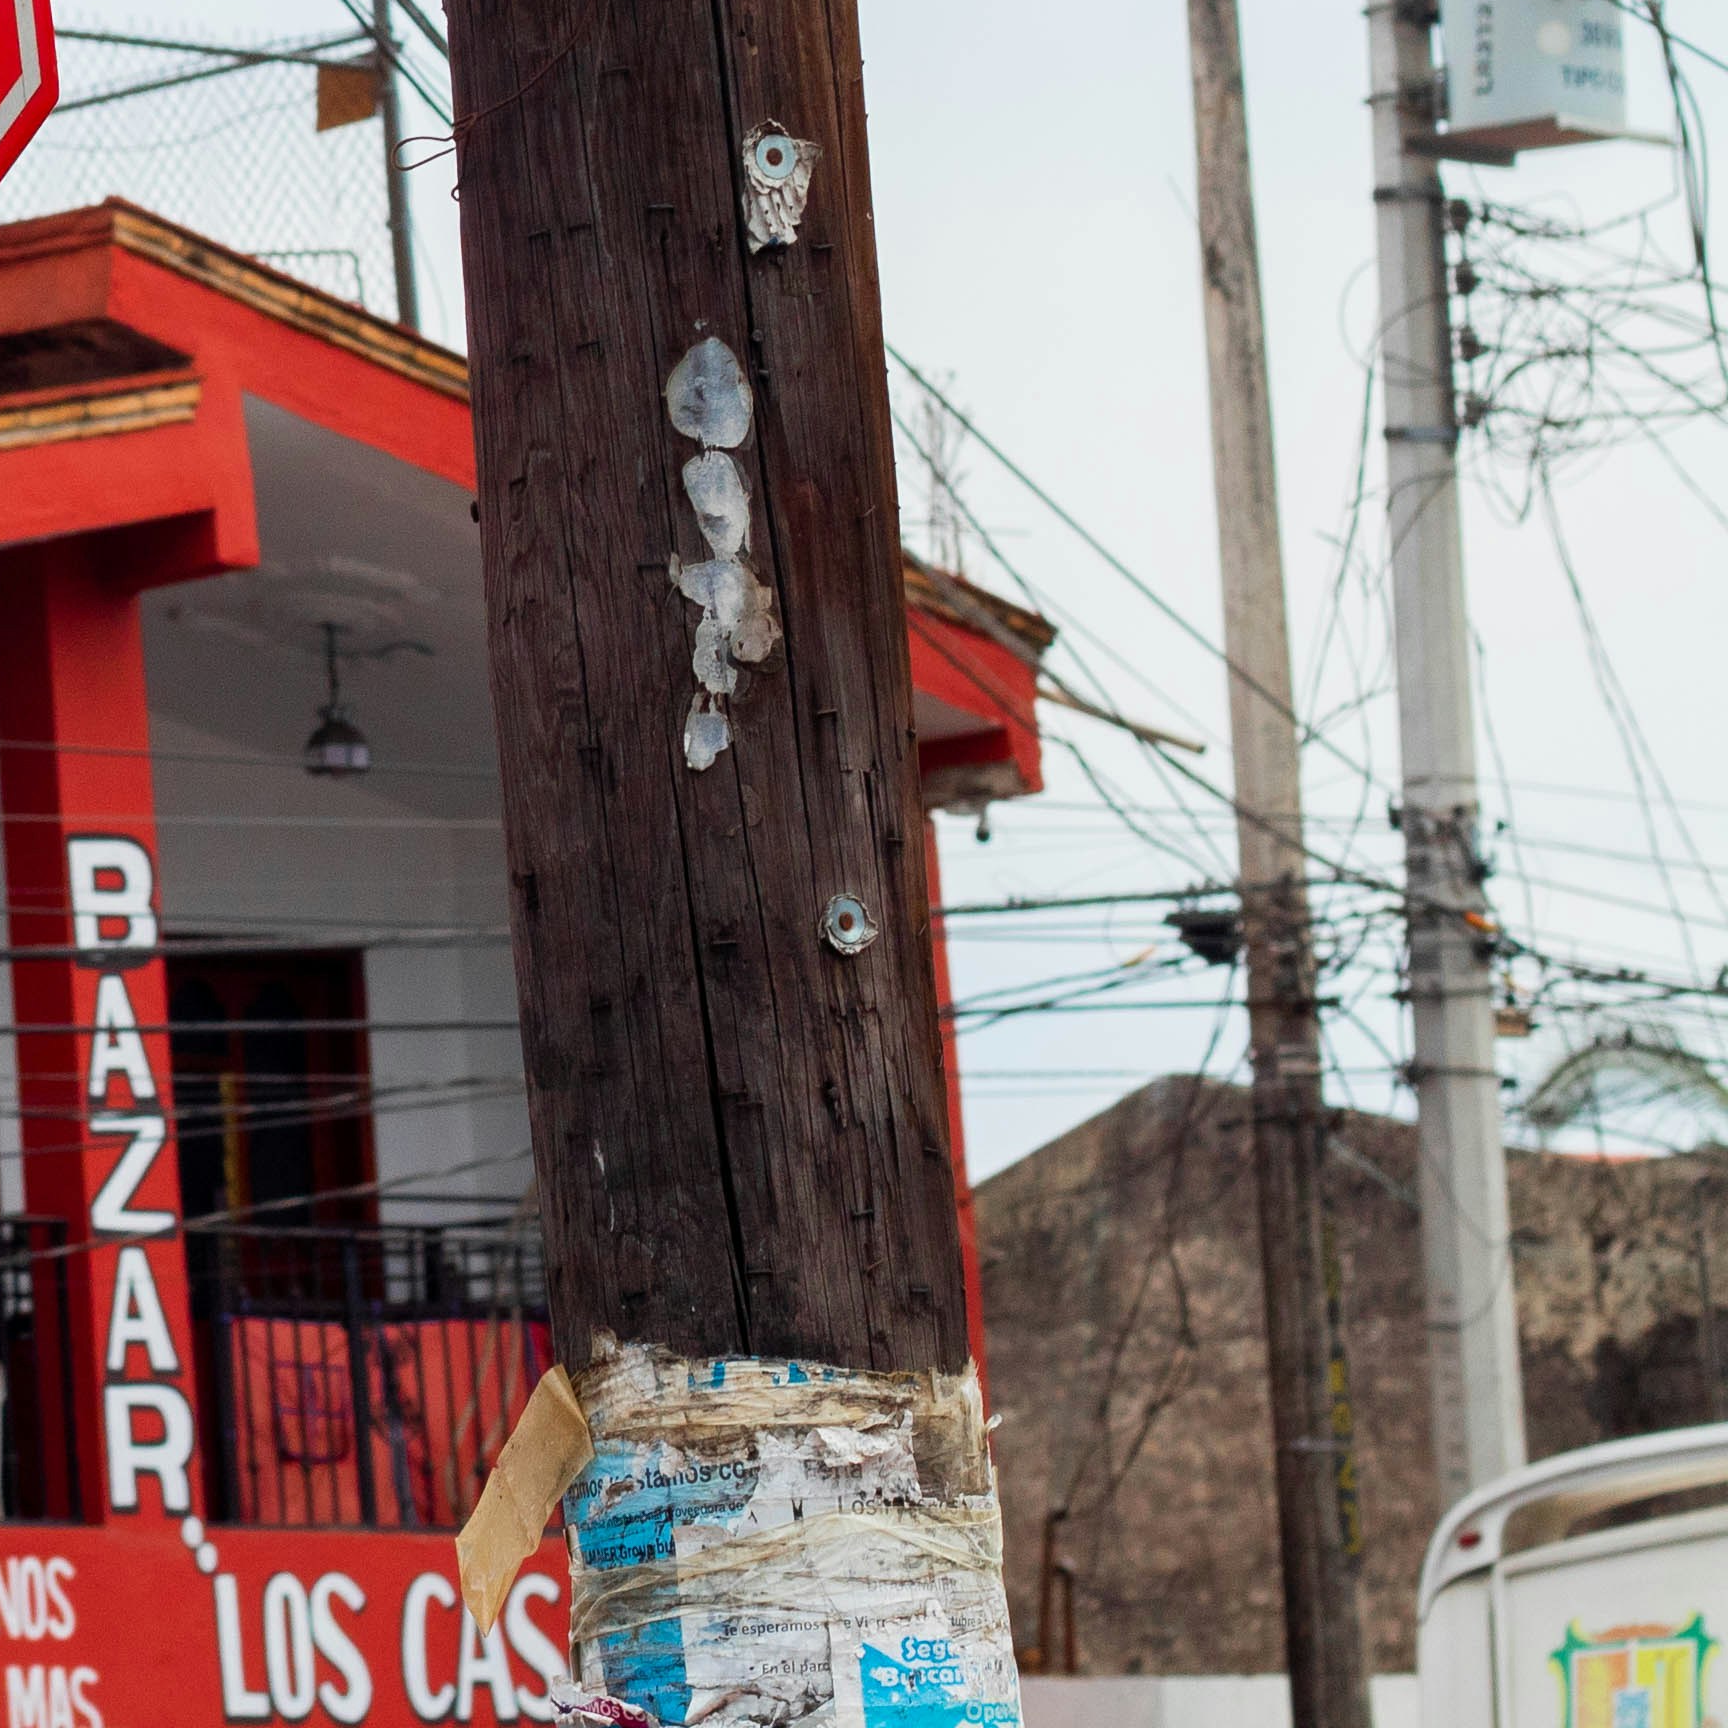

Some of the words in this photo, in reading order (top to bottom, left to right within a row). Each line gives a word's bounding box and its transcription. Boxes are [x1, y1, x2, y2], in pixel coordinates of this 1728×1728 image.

[66, 834, 196, 1514] BAZAR
[5, 1665, 104, 1728] MAS
[213, 1571, 373, 1725] LOS
